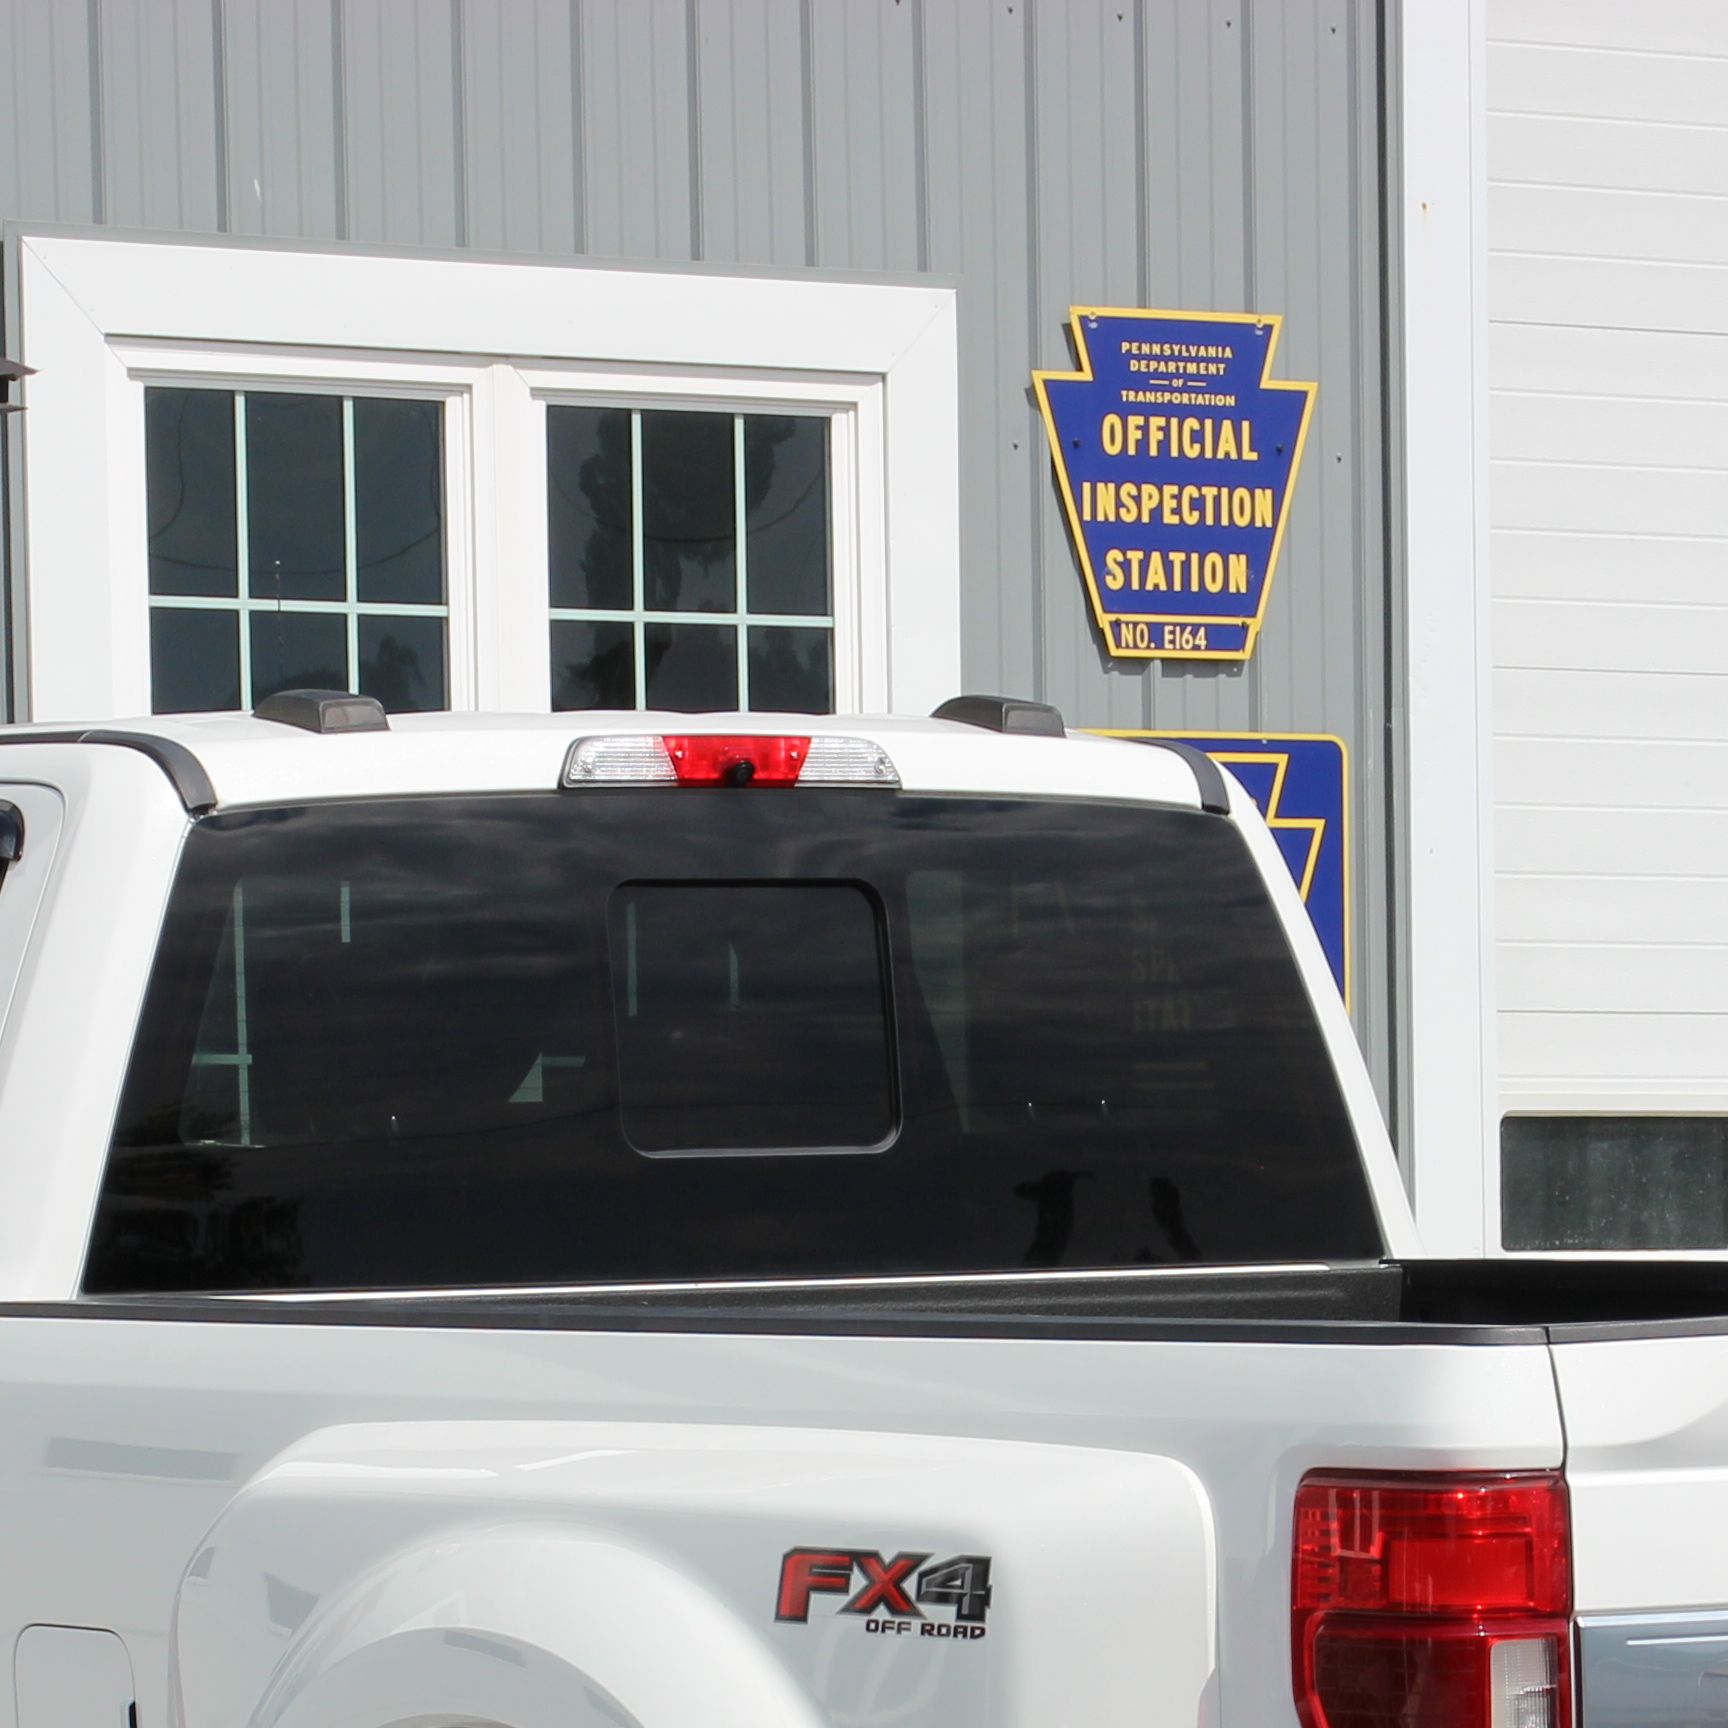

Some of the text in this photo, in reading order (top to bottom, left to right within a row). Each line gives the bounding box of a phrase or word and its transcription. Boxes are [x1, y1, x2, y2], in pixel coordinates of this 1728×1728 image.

[1120, 341, 1234, 359] PENNSYLVANIA
[1129, 359, 1227, 376] DEPARTMENT
[1171, 378, 1184, 388] OF
[1120, 390, 1236, 407] TRANSPORTATION
[1101, 412, 1259, 462] OFFICIAL
[1081, 480, 1274, 529] INSPECTION
[1104, 548, 1248, 594] STATION
[1120, 622, 1156, 649] NO.
[774, 1546, 993, 1625] FX4
[865, 1619, 987, 1641] OFF ROAD
